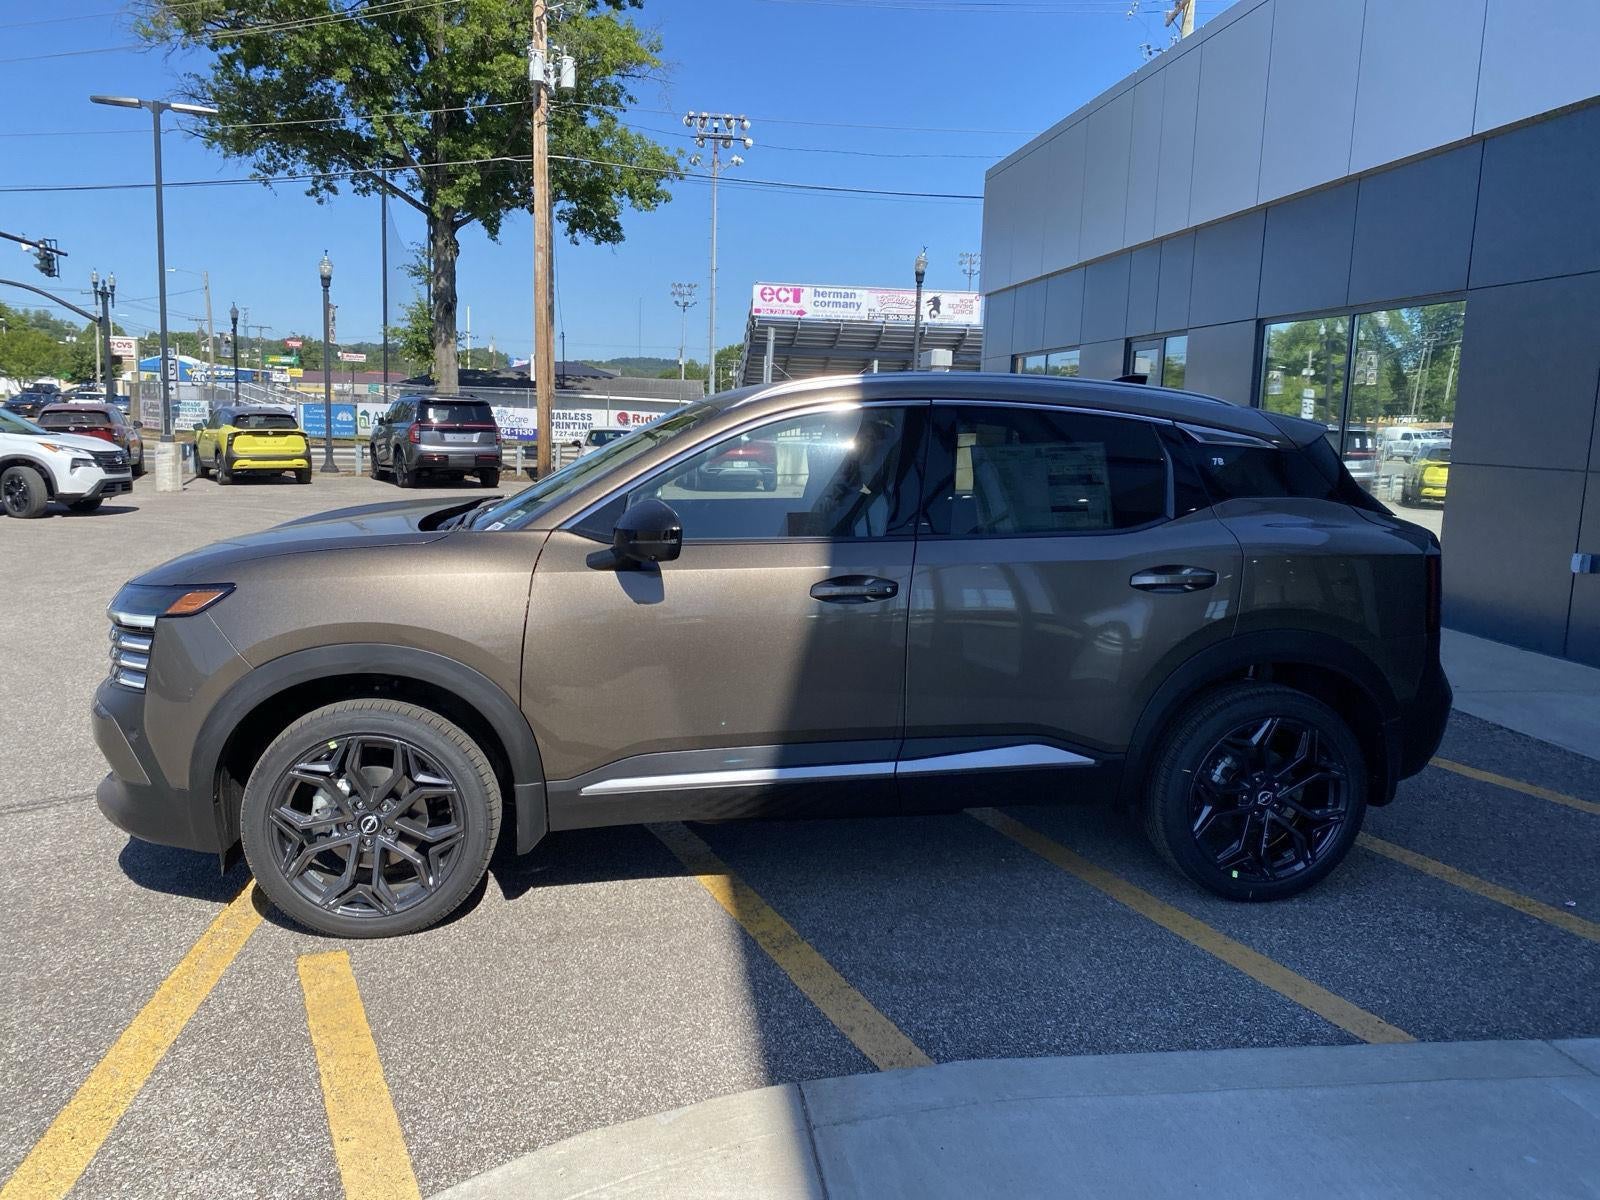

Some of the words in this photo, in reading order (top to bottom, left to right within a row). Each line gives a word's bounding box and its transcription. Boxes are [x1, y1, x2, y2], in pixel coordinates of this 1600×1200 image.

[813, 289, 857, 299] herman
[813, 299, 862, 311] cormany
[116, 341, 133, 349] CVS
